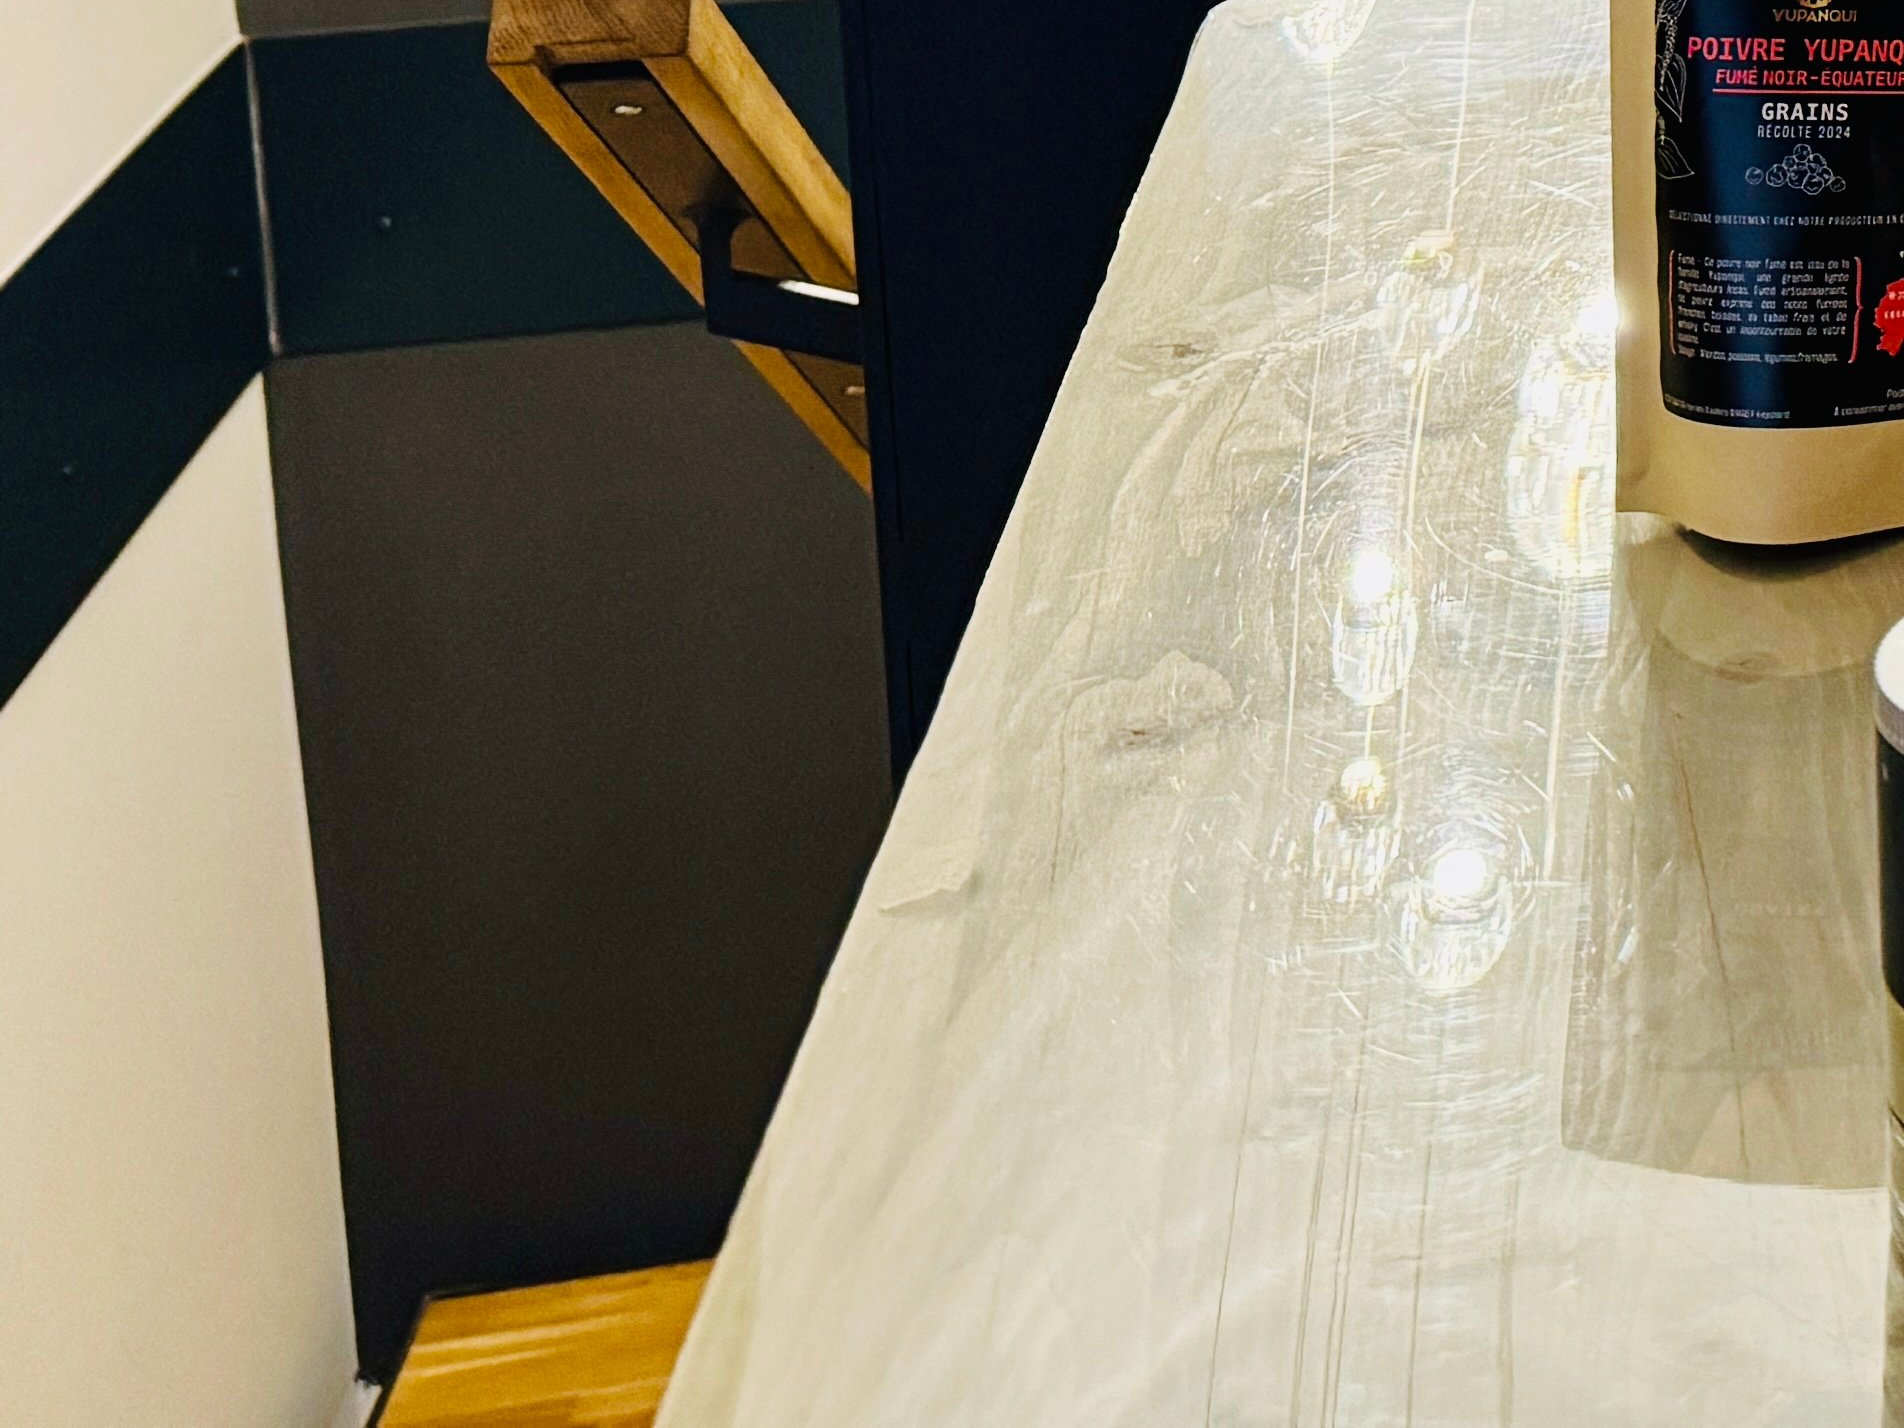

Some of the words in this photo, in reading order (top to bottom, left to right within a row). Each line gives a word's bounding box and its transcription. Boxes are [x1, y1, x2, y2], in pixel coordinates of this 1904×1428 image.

[1772, 9, 1857, 24] YUPANQUI
[1687, 36, 1785, 62] POIVRE
[1715, 65, 1758, 86] FUMÉ
[1761, 102, 1849, 122] GRAINS
[1757, 123, 1812, 139] RÉCOLTE
[1818, 126, 1851, 139] 2024
